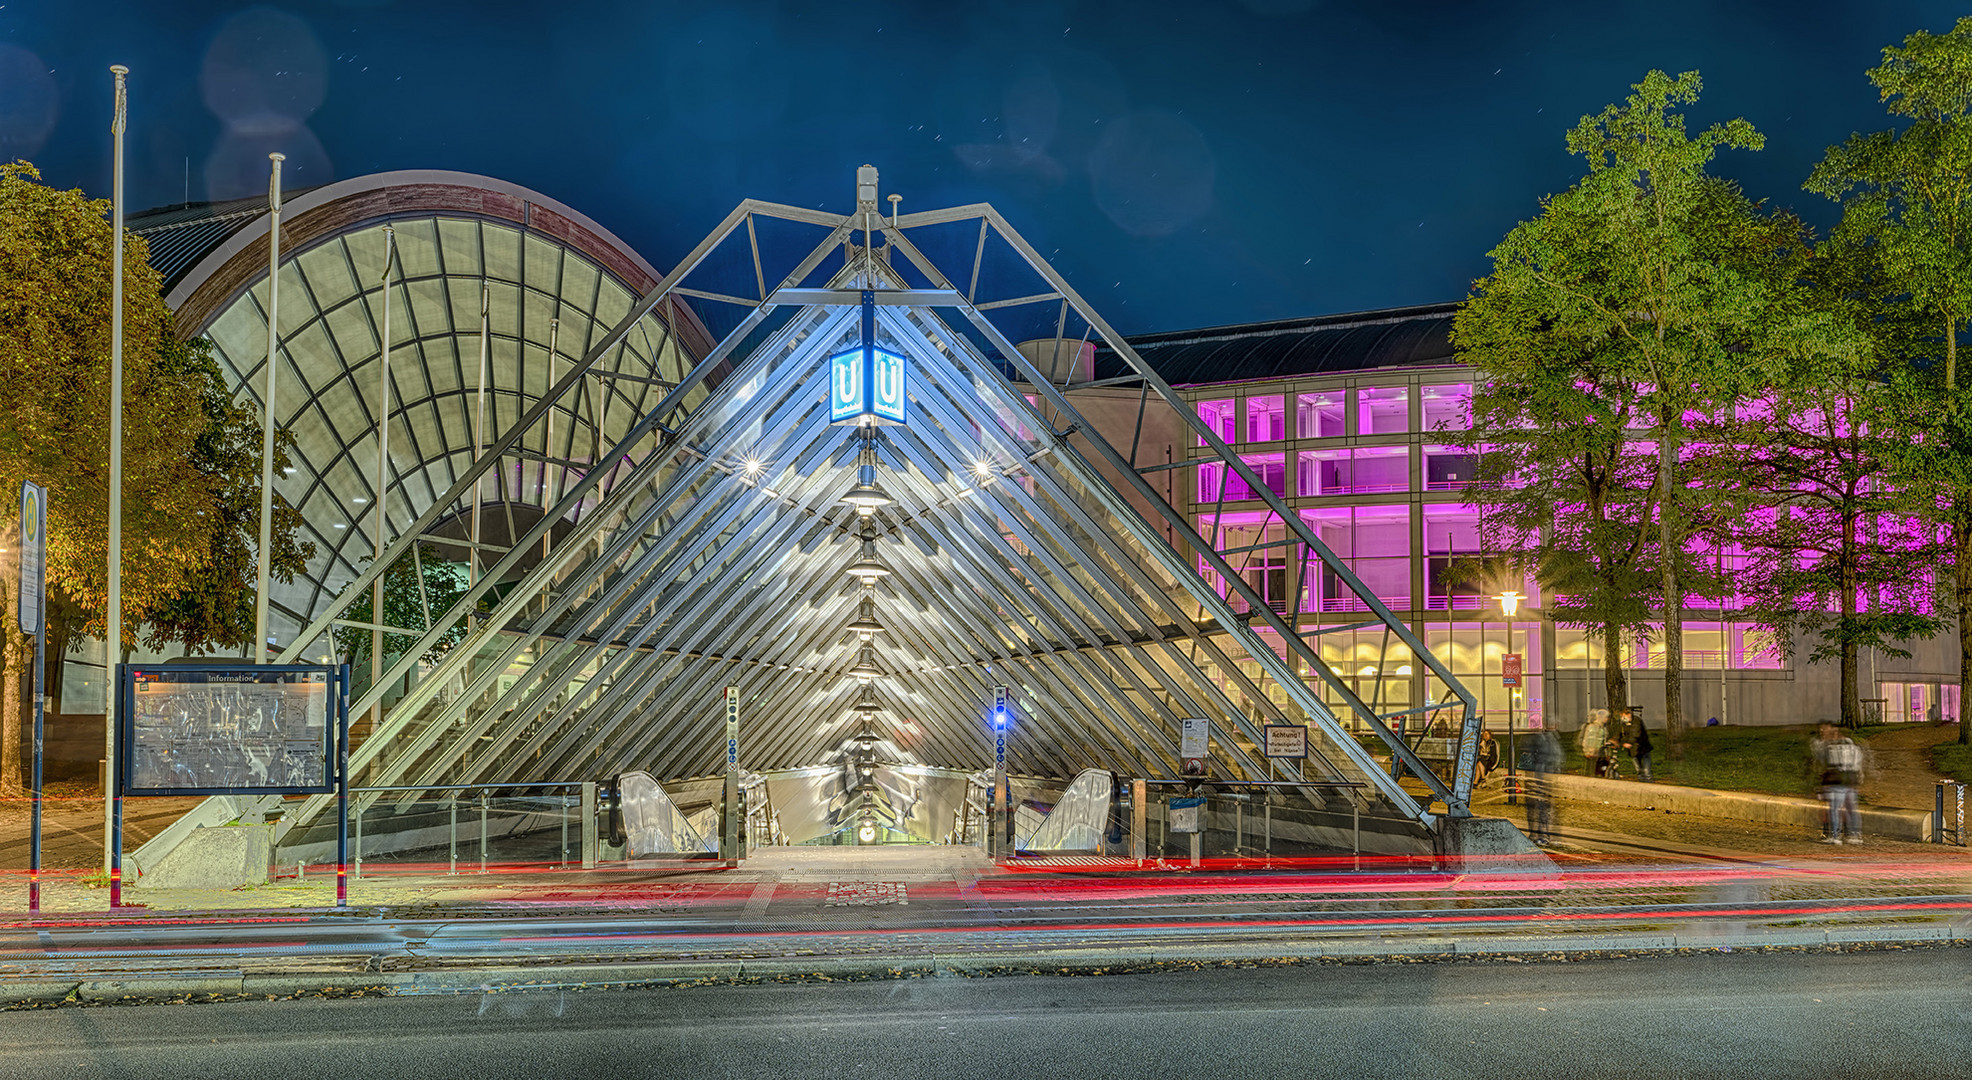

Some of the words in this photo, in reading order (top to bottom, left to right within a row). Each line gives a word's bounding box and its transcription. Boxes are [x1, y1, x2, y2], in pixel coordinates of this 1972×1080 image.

[840, 360, 856, 403] U
[880, 361, 896, 403] U
[28, 502, 34, 530] H
[208, 674, 254, 682] Information
